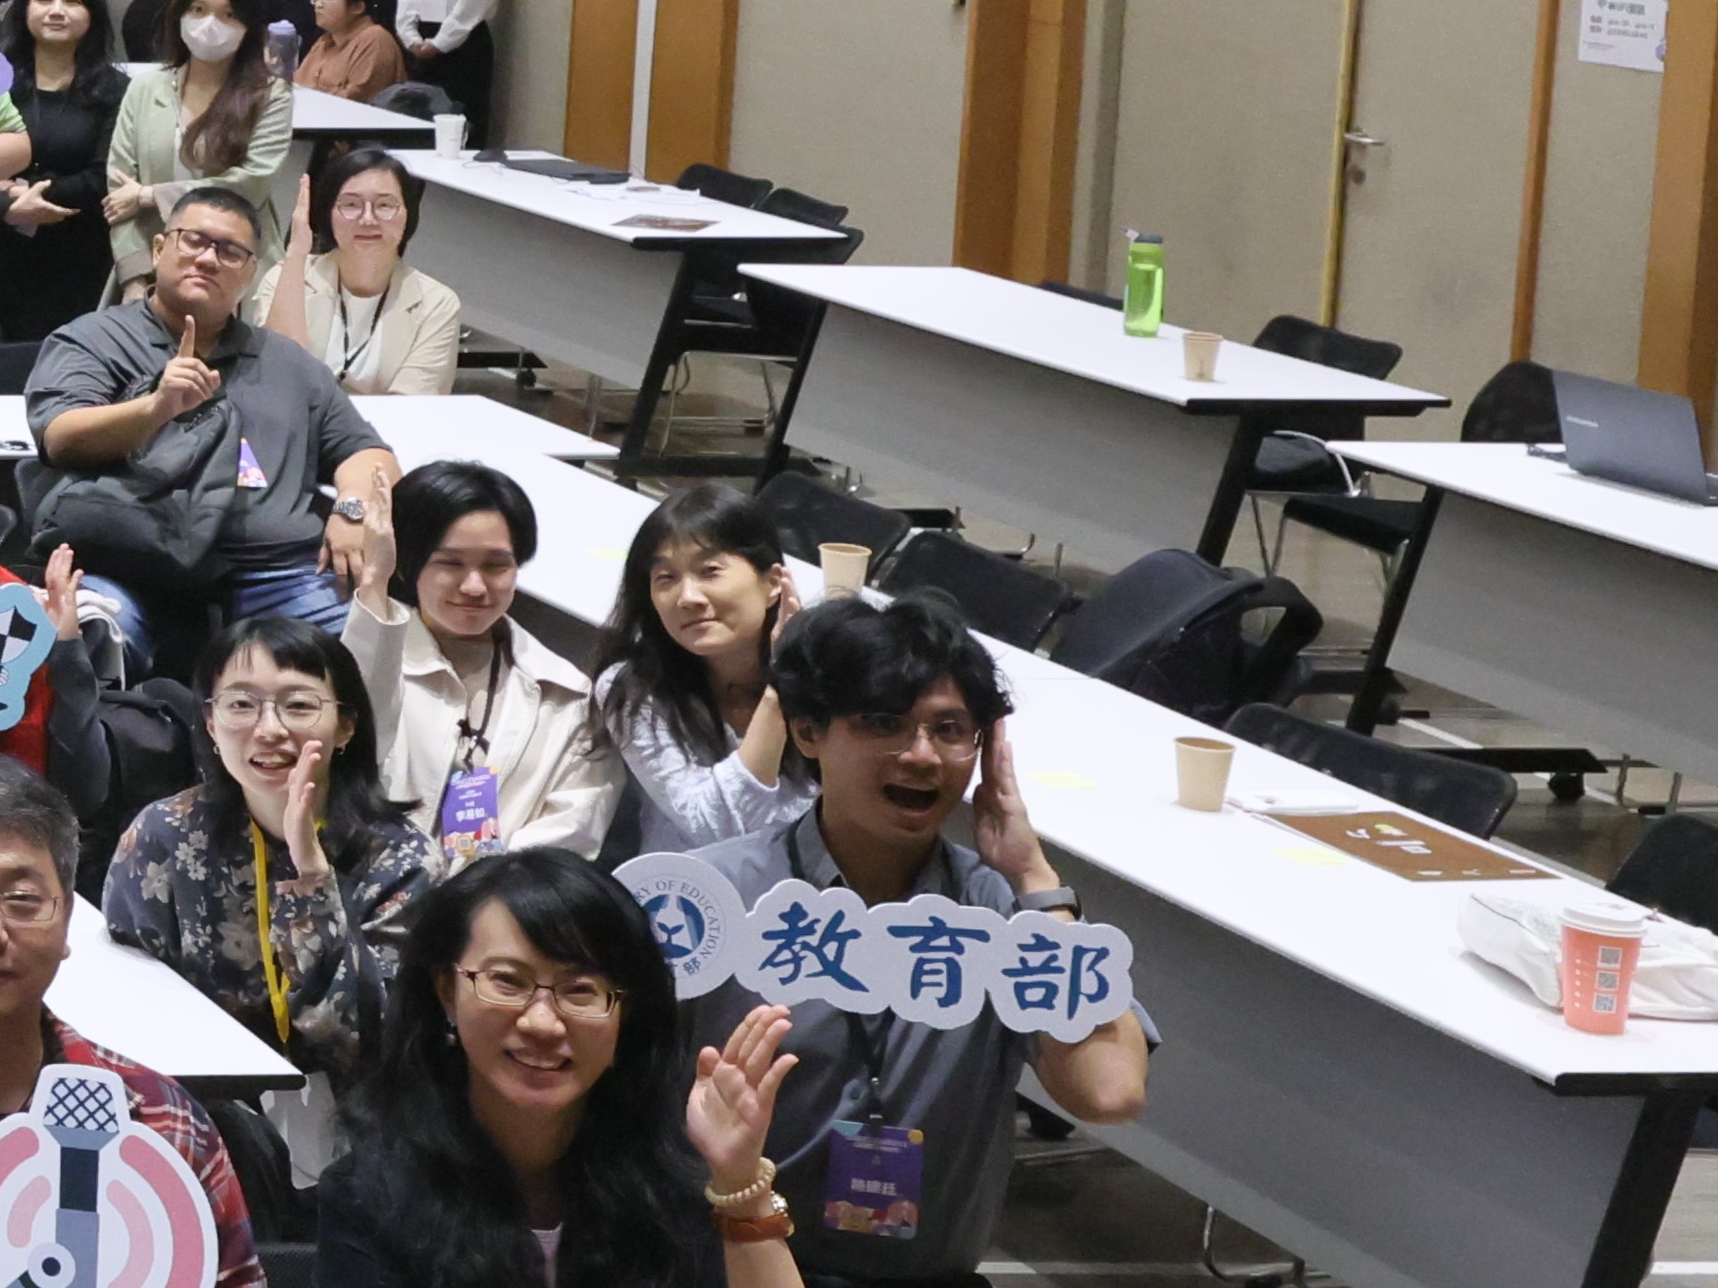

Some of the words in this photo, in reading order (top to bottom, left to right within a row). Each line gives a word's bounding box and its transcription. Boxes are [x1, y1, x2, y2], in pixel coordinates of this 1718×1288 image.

[681, 882, 719, 959] EDUCATION
[759, 901, 1112, 1022] 教育部
